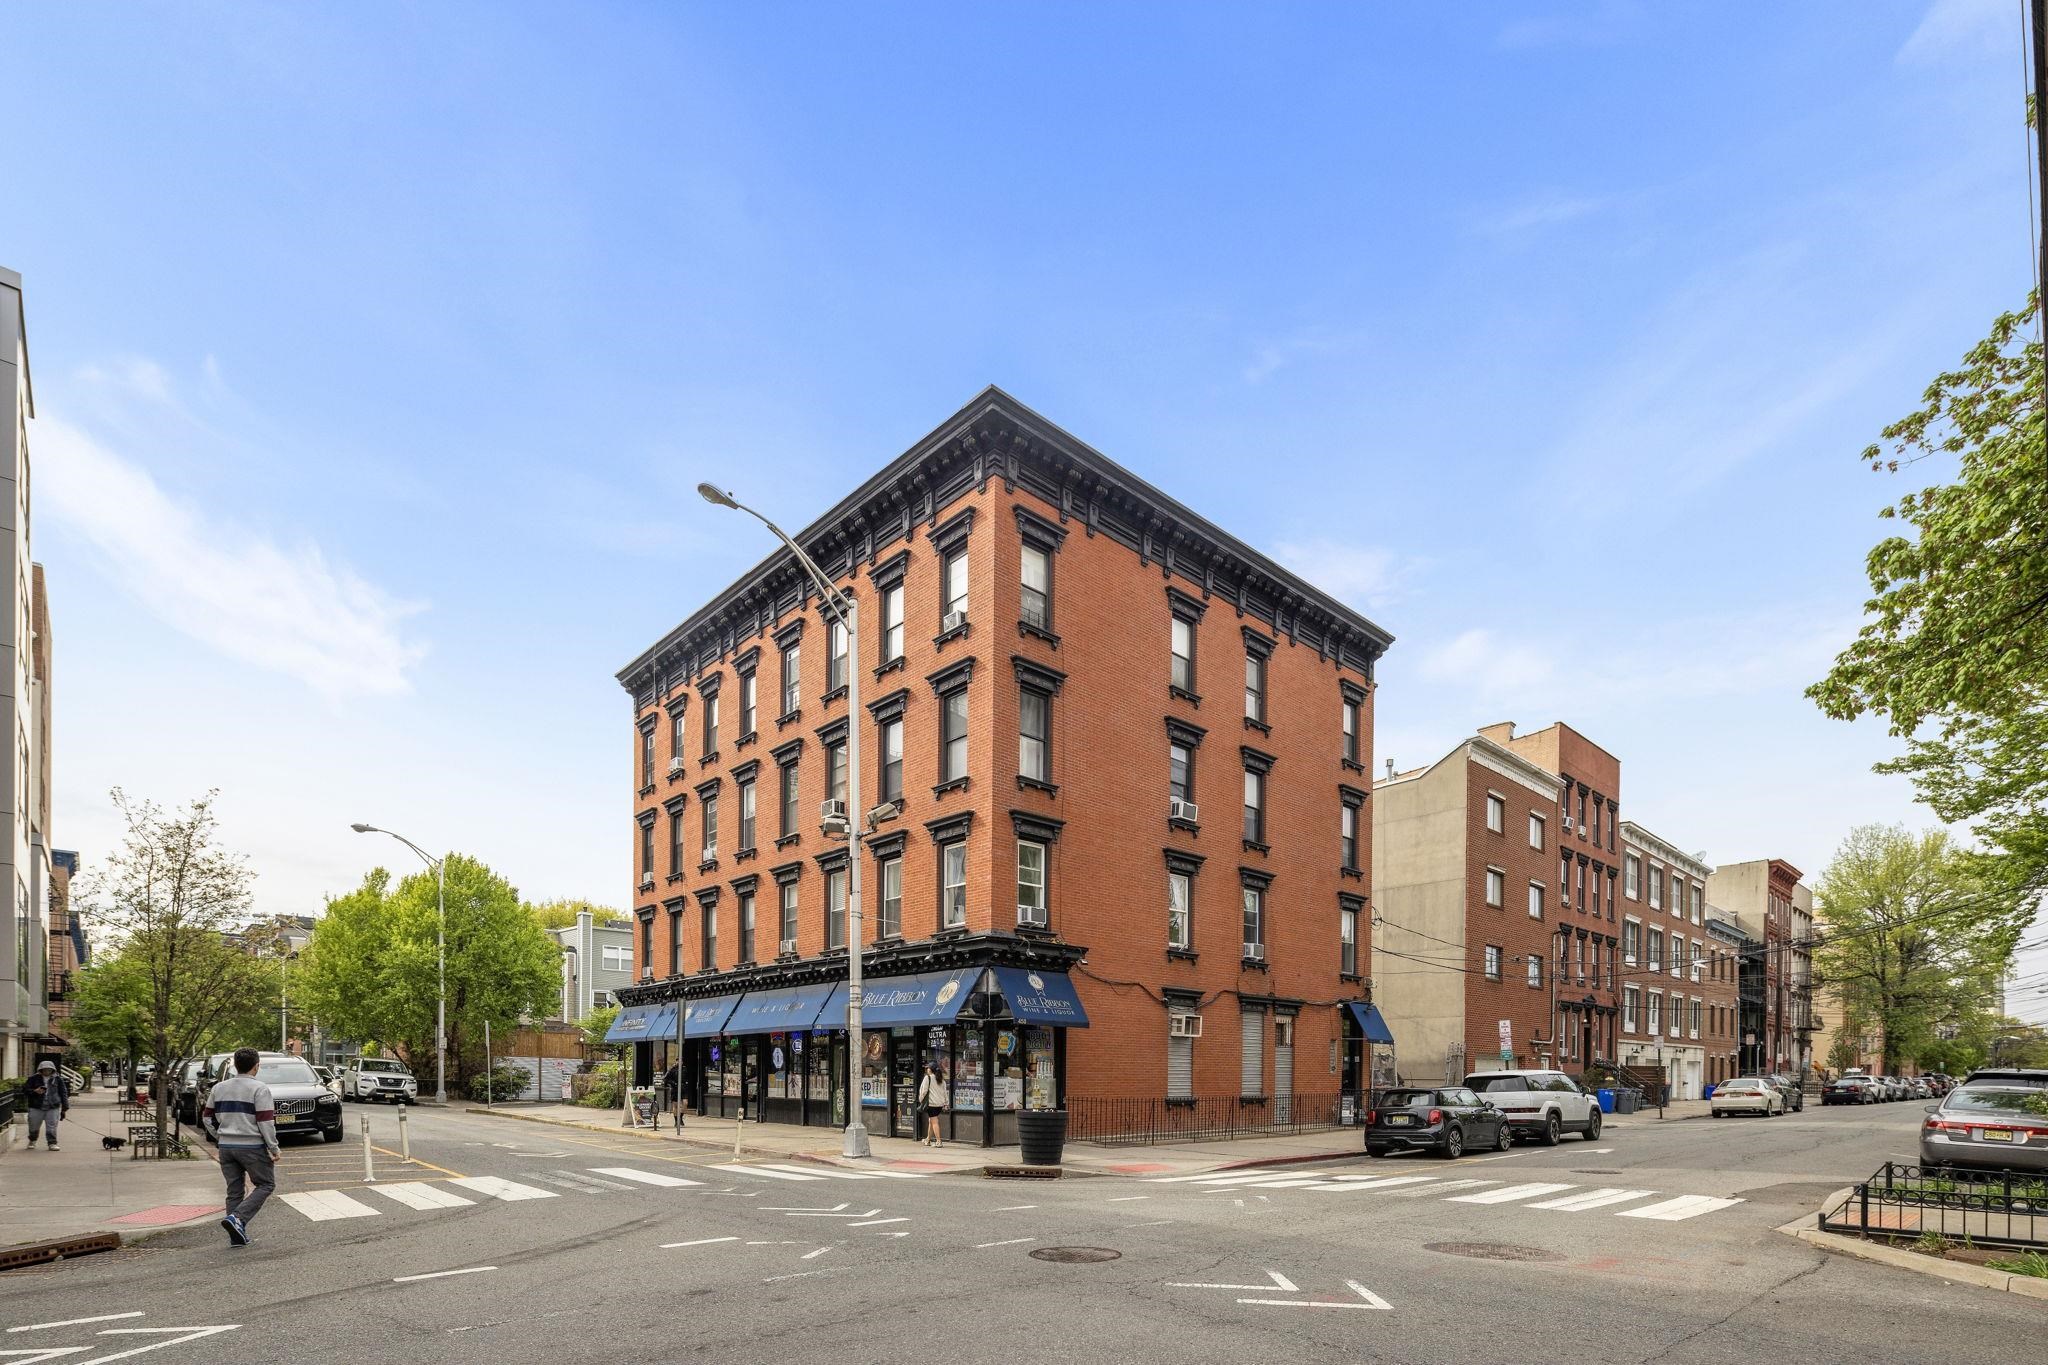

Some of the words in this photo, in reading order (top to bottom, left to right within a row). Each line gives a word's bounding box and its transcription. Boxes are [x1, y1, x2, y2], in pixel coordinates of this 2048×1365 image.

[860, 992, 888, 1009] BLUE
[886, 990, 928, 1007] RIBBON
[1016, 995, 1038, 1008] BLUE
[1039, 997, 1072, 1009] RIBBON
[928, 1031, 947, 1039] ULTRA
